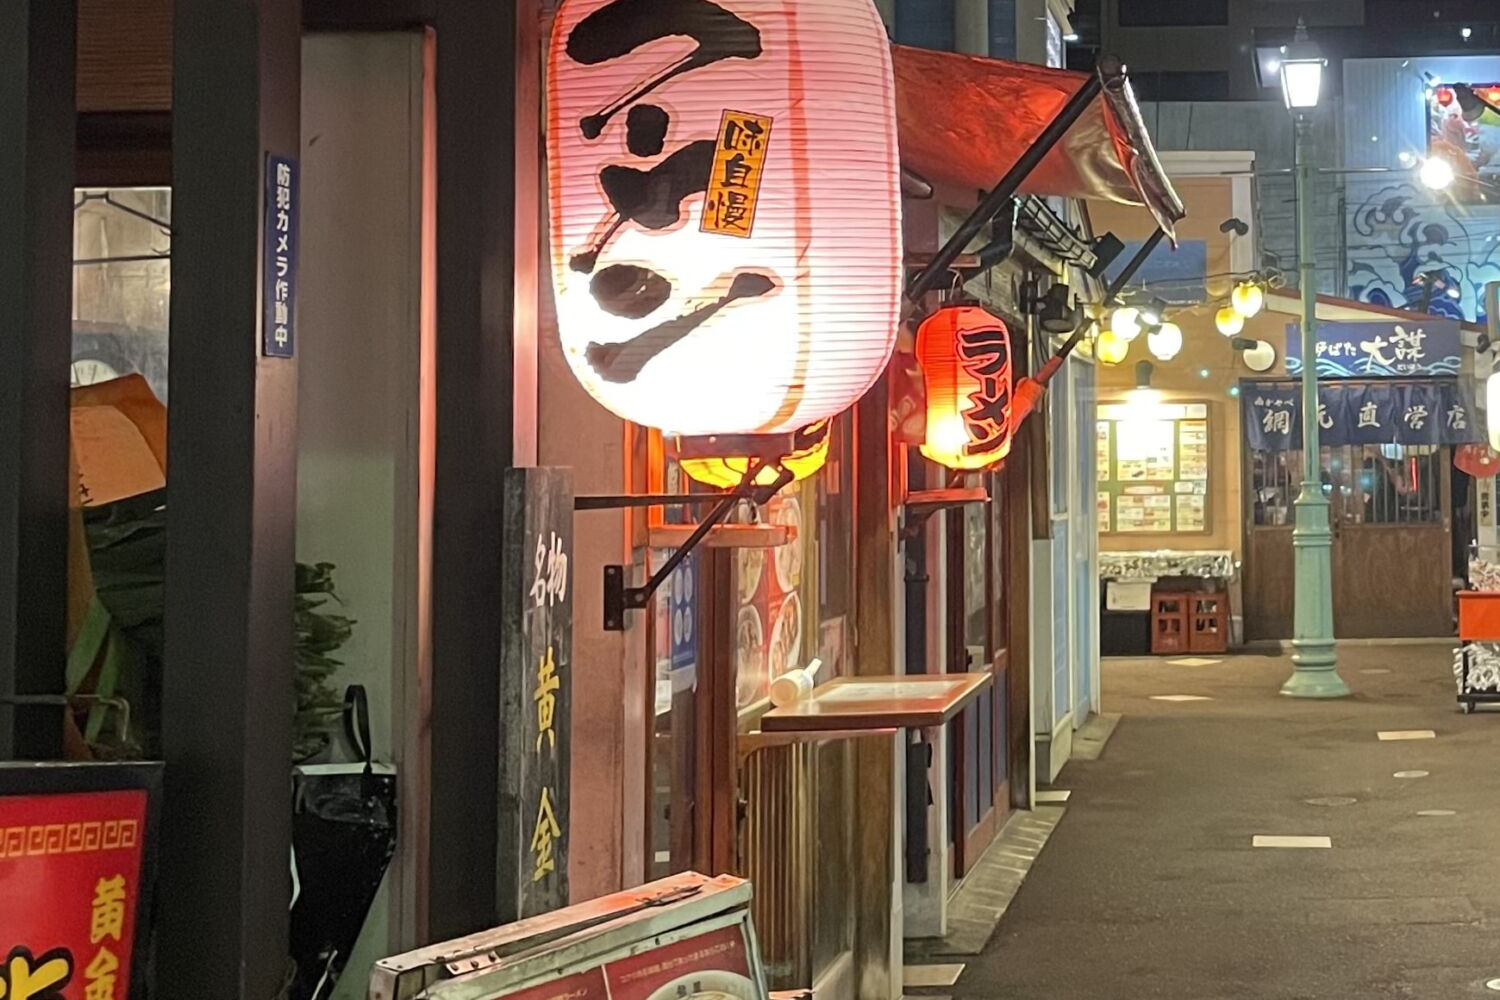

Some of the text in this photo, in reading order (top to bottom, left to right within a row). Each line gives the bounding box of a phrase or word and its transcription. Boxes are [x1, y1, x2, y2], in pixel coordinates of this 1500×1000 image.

[708, 119, 764, 230] 味自慢
[275, 162, 291, 348] 防犯カメラ作動中
[960, 329, 1009, 456] ラーメン
[530, 531, 568, 882] 名物 黄金
